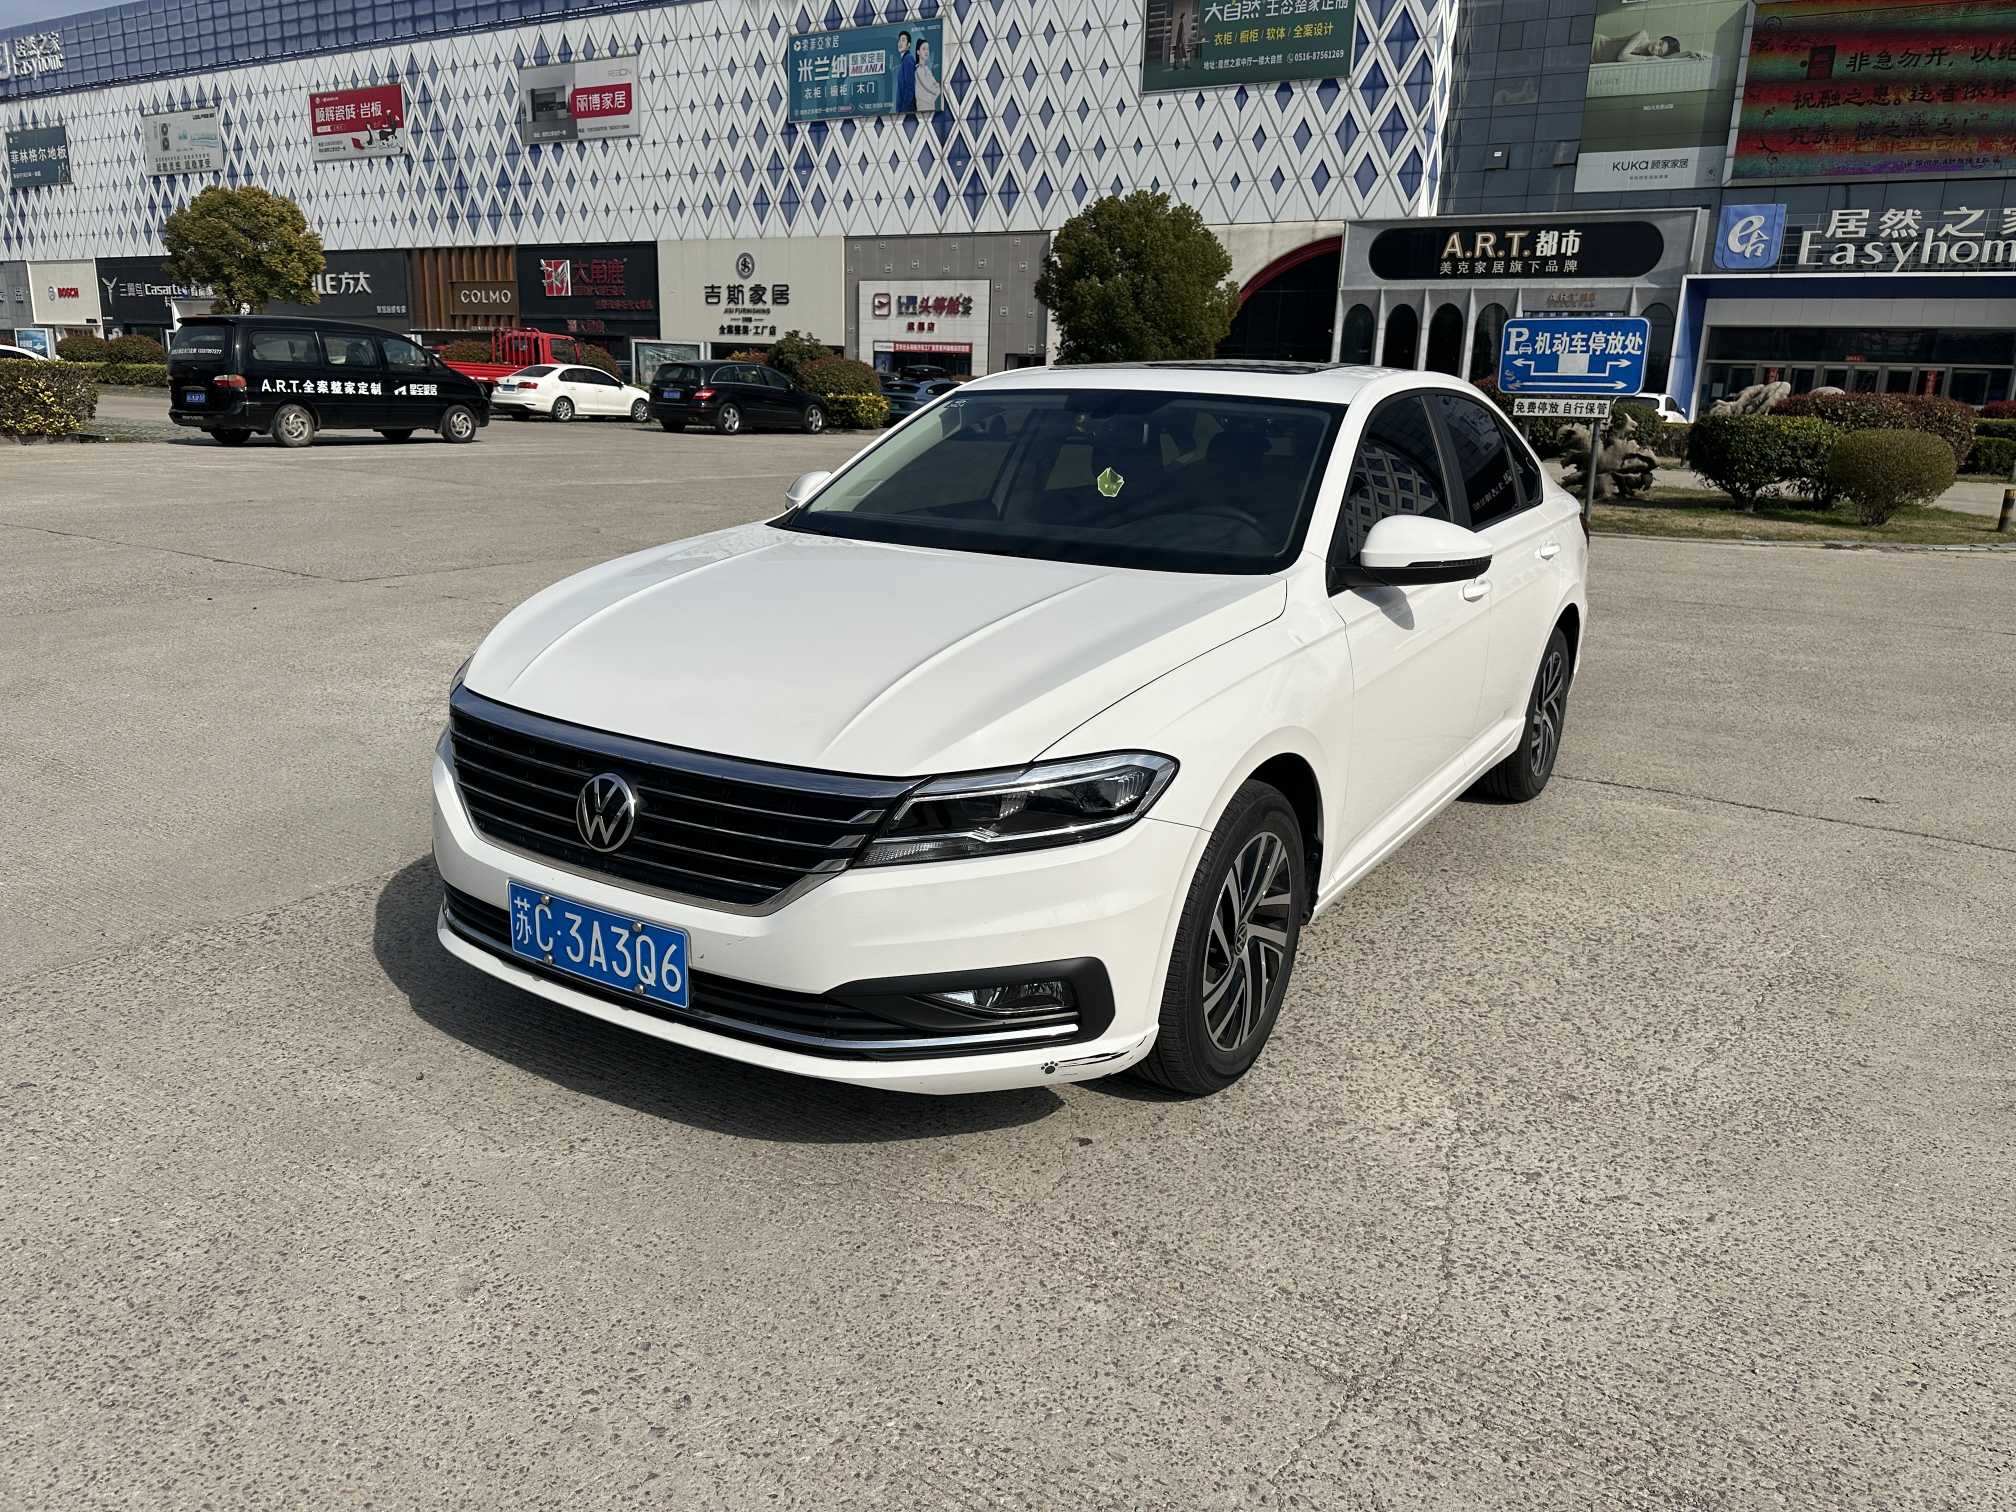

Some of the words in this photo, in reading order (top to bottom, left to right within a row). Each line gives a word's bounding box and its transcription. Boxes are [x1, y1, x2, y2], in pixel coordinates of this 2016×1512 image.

[1214, 31, 1233, 46] 衣柜
[1239, 29, 1259, 43] 橱柜
[1266, 26, 1286, 41] 软体
[1293, 22, 1334, 39] 全案设计
[797, 55, 848, 83] 米兰纳
[856, 81, 875, 94] 木门
[575, 91, 626, 112] 丽博家居
[1440, 260, 1578, 275] 美克家居旗下品牌
[339, 271, 372, 294] 方太
[460, 289, 512, 304] COLMO
[704, 284, 789, 305] 吉斯家居
[1505, 327, 1530, 356] P
[1534, 331, 1643, 356] 机动车停放处
[1515, 401, 1559, 414] 免费停放
[1563, 401, 1607, 416] 自行保管
